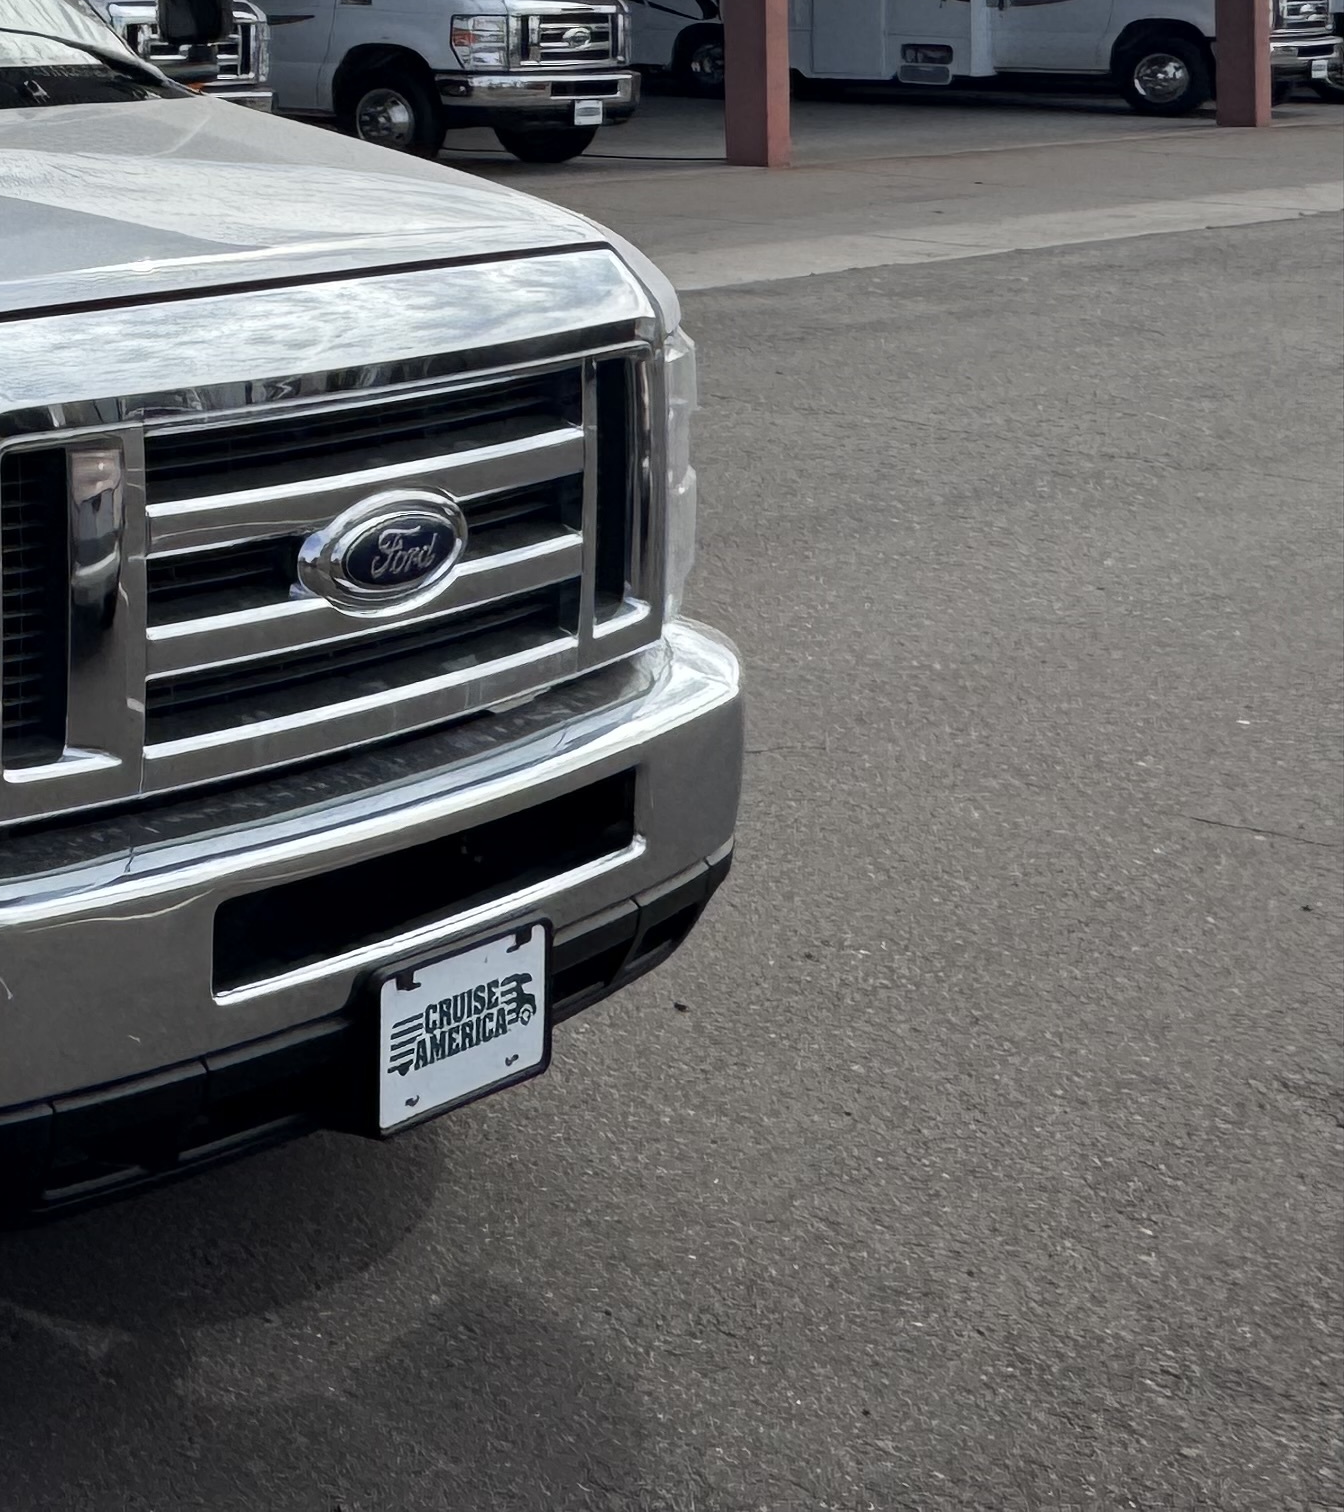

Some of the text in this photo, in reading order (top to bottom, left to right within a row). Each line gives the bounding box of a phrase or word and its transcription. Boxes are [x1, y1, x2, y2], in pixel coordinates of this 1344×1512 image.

[370, 525, 438, 579] Ford
[425, 978, 500, 1034] CRUISE
[414, 1007, 507, 1071] AMERICA
